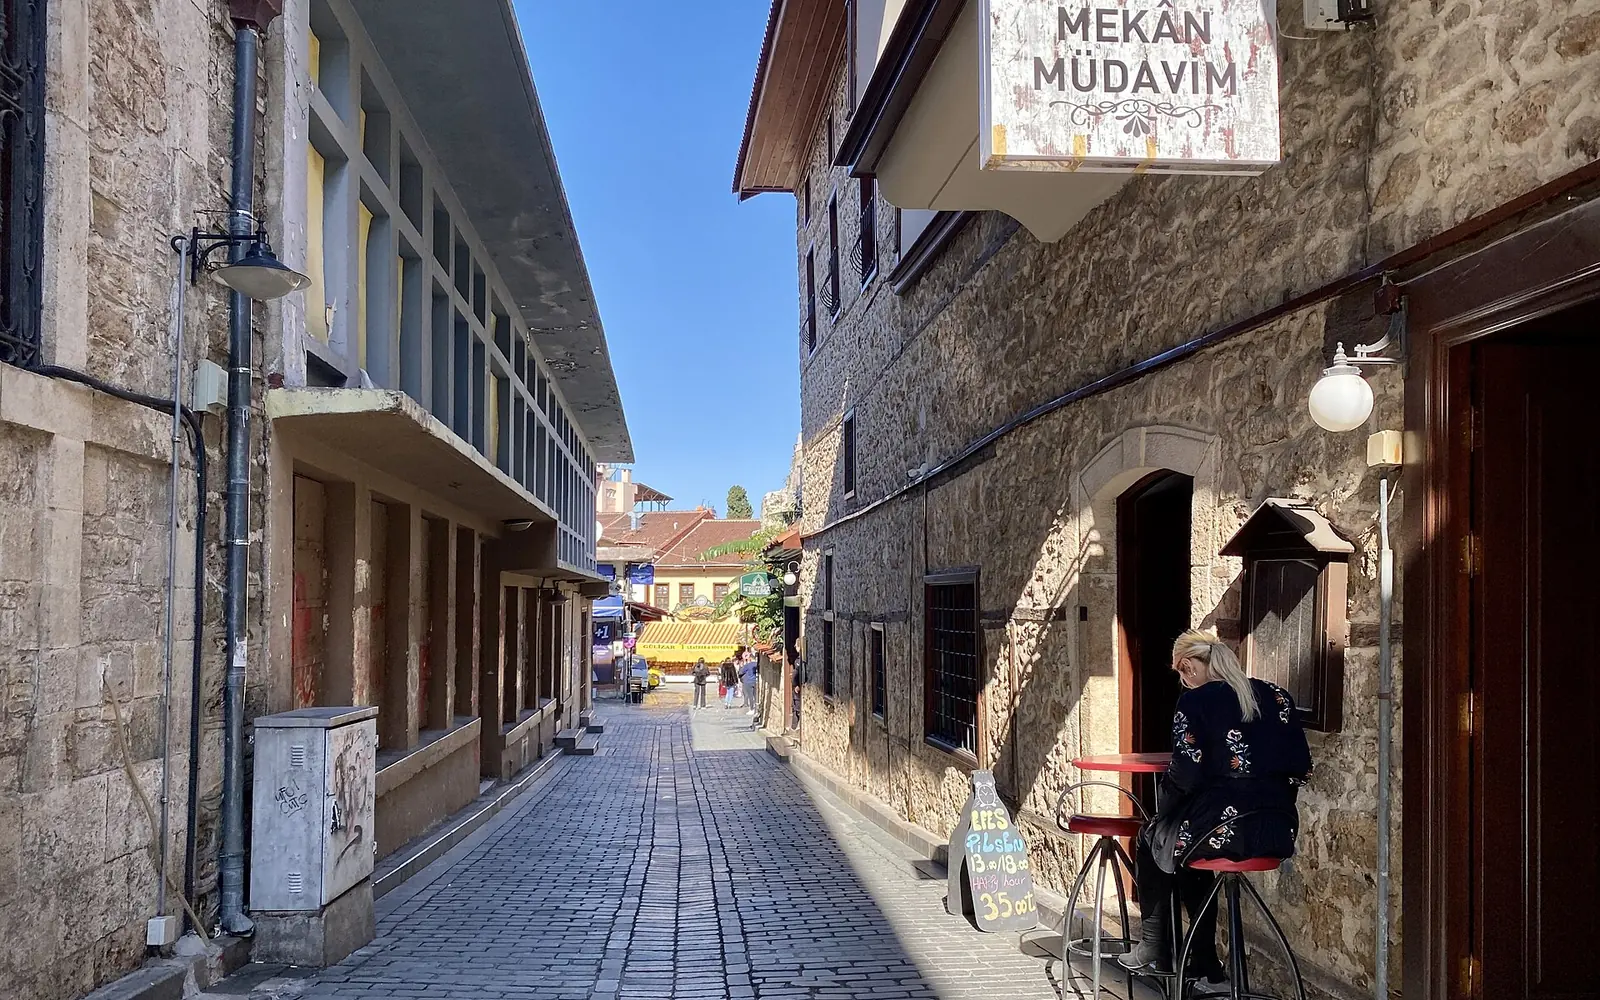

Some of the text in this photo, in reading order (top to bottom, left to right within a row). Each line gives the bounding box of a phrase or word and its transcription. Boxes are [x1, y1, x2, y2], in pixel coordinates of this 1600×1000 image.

[1057, 0, 1211, 45] MEKÂN
[1033, 49, 1237, 96] MÜDAVİM
[971, 808, 1009, 831] EFES
